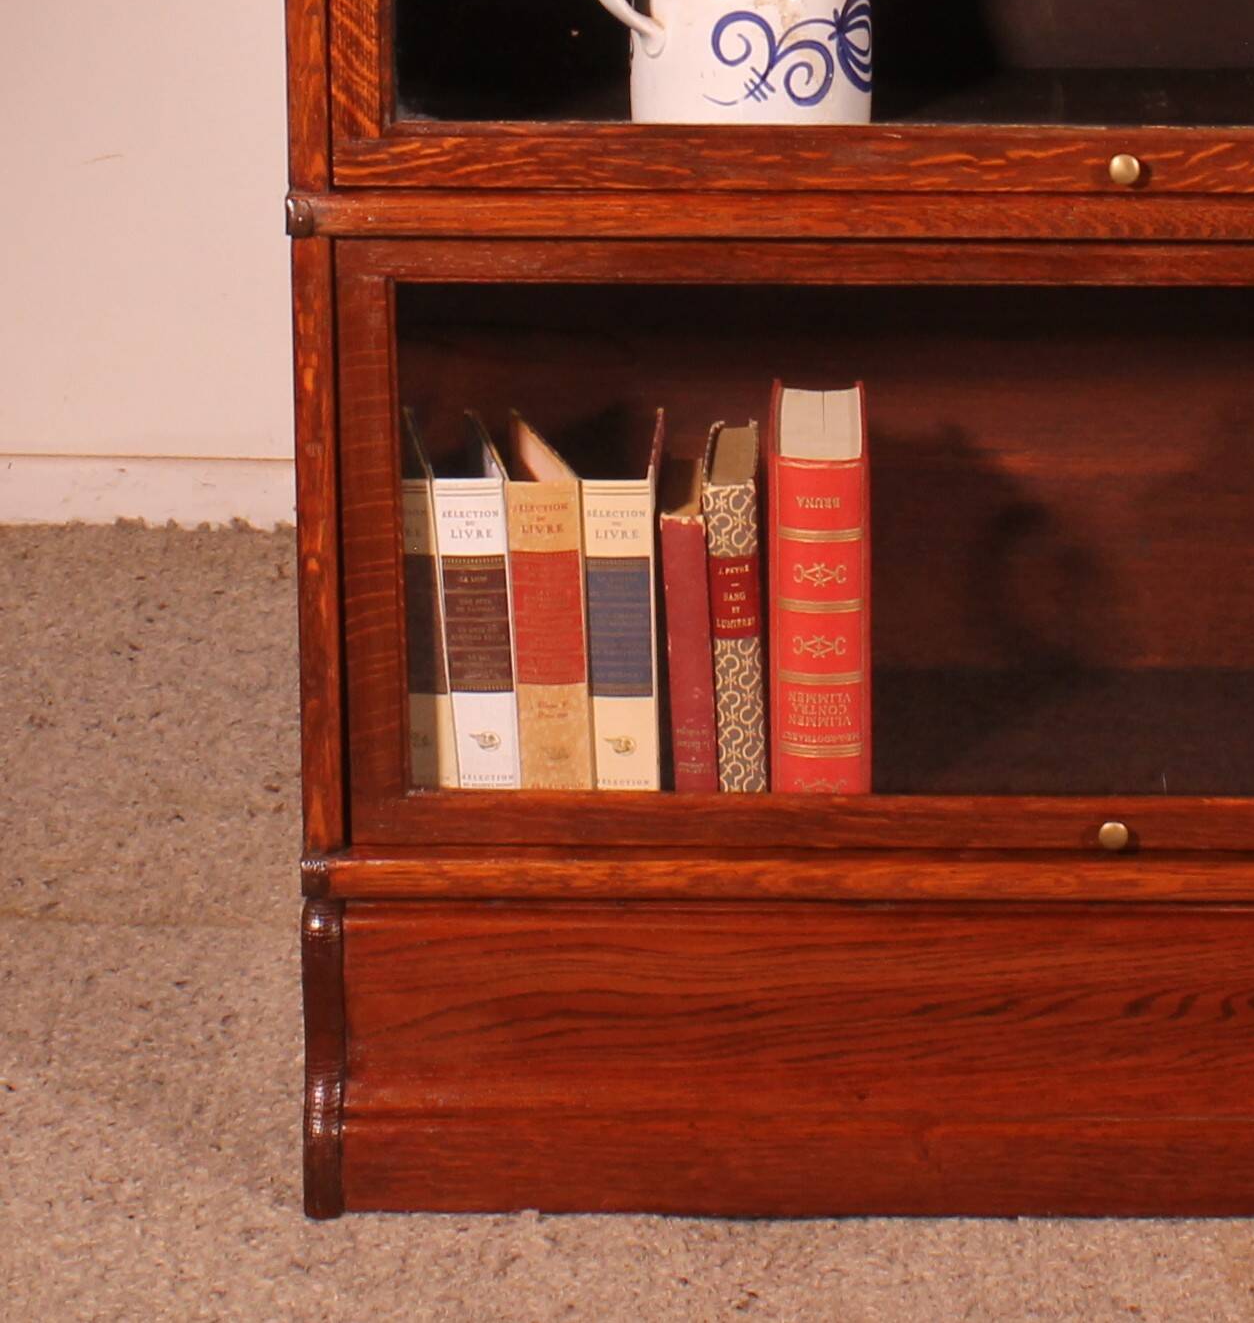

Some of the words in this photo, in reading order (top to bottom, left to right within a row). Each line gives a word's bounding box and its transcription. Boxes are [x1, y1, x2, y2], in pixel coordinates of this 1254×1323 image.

[796, 496, 841, 509] BRUNA
[451, 528, 495, 540] LIVRE
[522, 524, 564, 536] LIVRE
[597, 529, 641, 540] LIVRE
[788, 691, 852, 704] VLIMMEN
[792, 703, 848, 717] CONTRA
[788, 715, 852, 728] VLIMMEN
